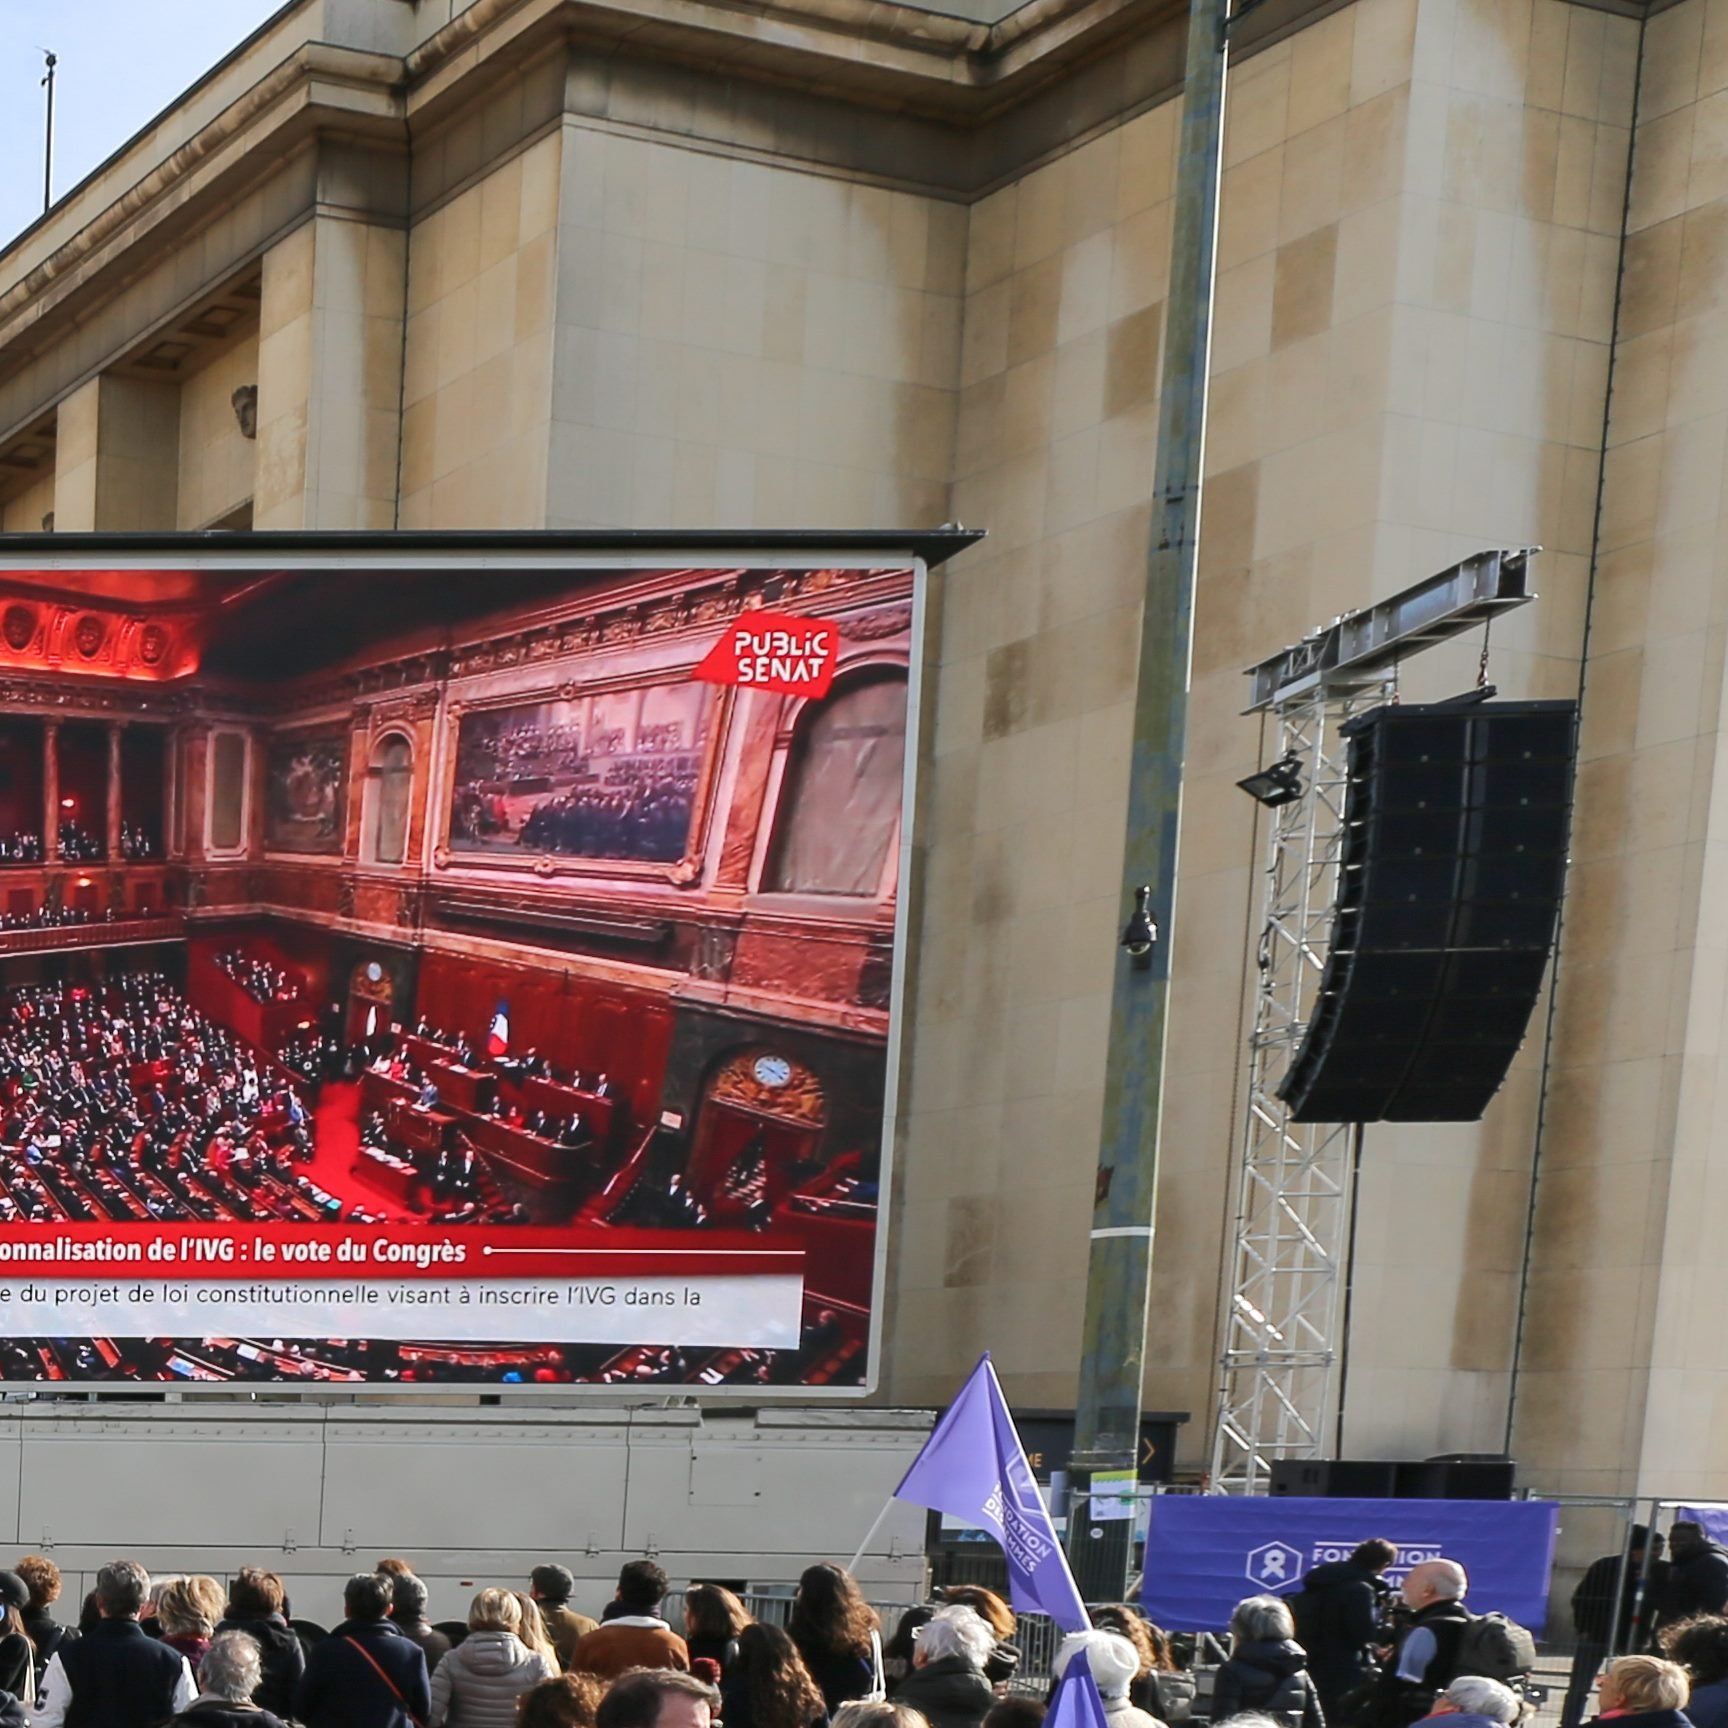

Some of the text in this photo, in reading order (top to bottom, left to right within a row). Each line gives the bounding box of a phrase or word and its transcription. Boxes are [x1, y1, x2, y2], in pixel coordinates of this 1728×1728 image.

[147, 1237, 176, 1262] de
[180, 1237, 235, 1262] l'IVG
[240, 1243, 247, 1262] :
[254, 1237, 276, 1262] le
[281, 1240, 331, 1263] vote
[336, 1237, 367, 1263] du
[372, 1238, 466, 1268] Congrès
[20, 1284, 46, 1303] du
[55, 1284, 119, 1307] projet
[128, 1284, 155, 1303] de
[163, 1284, 188, 1303] loi
[196, 1284, 379, 1304] constitutionnelle
[387, 1285, 450, 1304] visant
[459, 1286, 470, 1304] à
[478, 1285, 559, 1305] inscrire
[567, 1286, 616, 1305] l'IVG
[624, 1287, 675, 1306] dans
[683, 1287, 701, 1306] la
[1312, 1547, 1442, 1565] FONION
